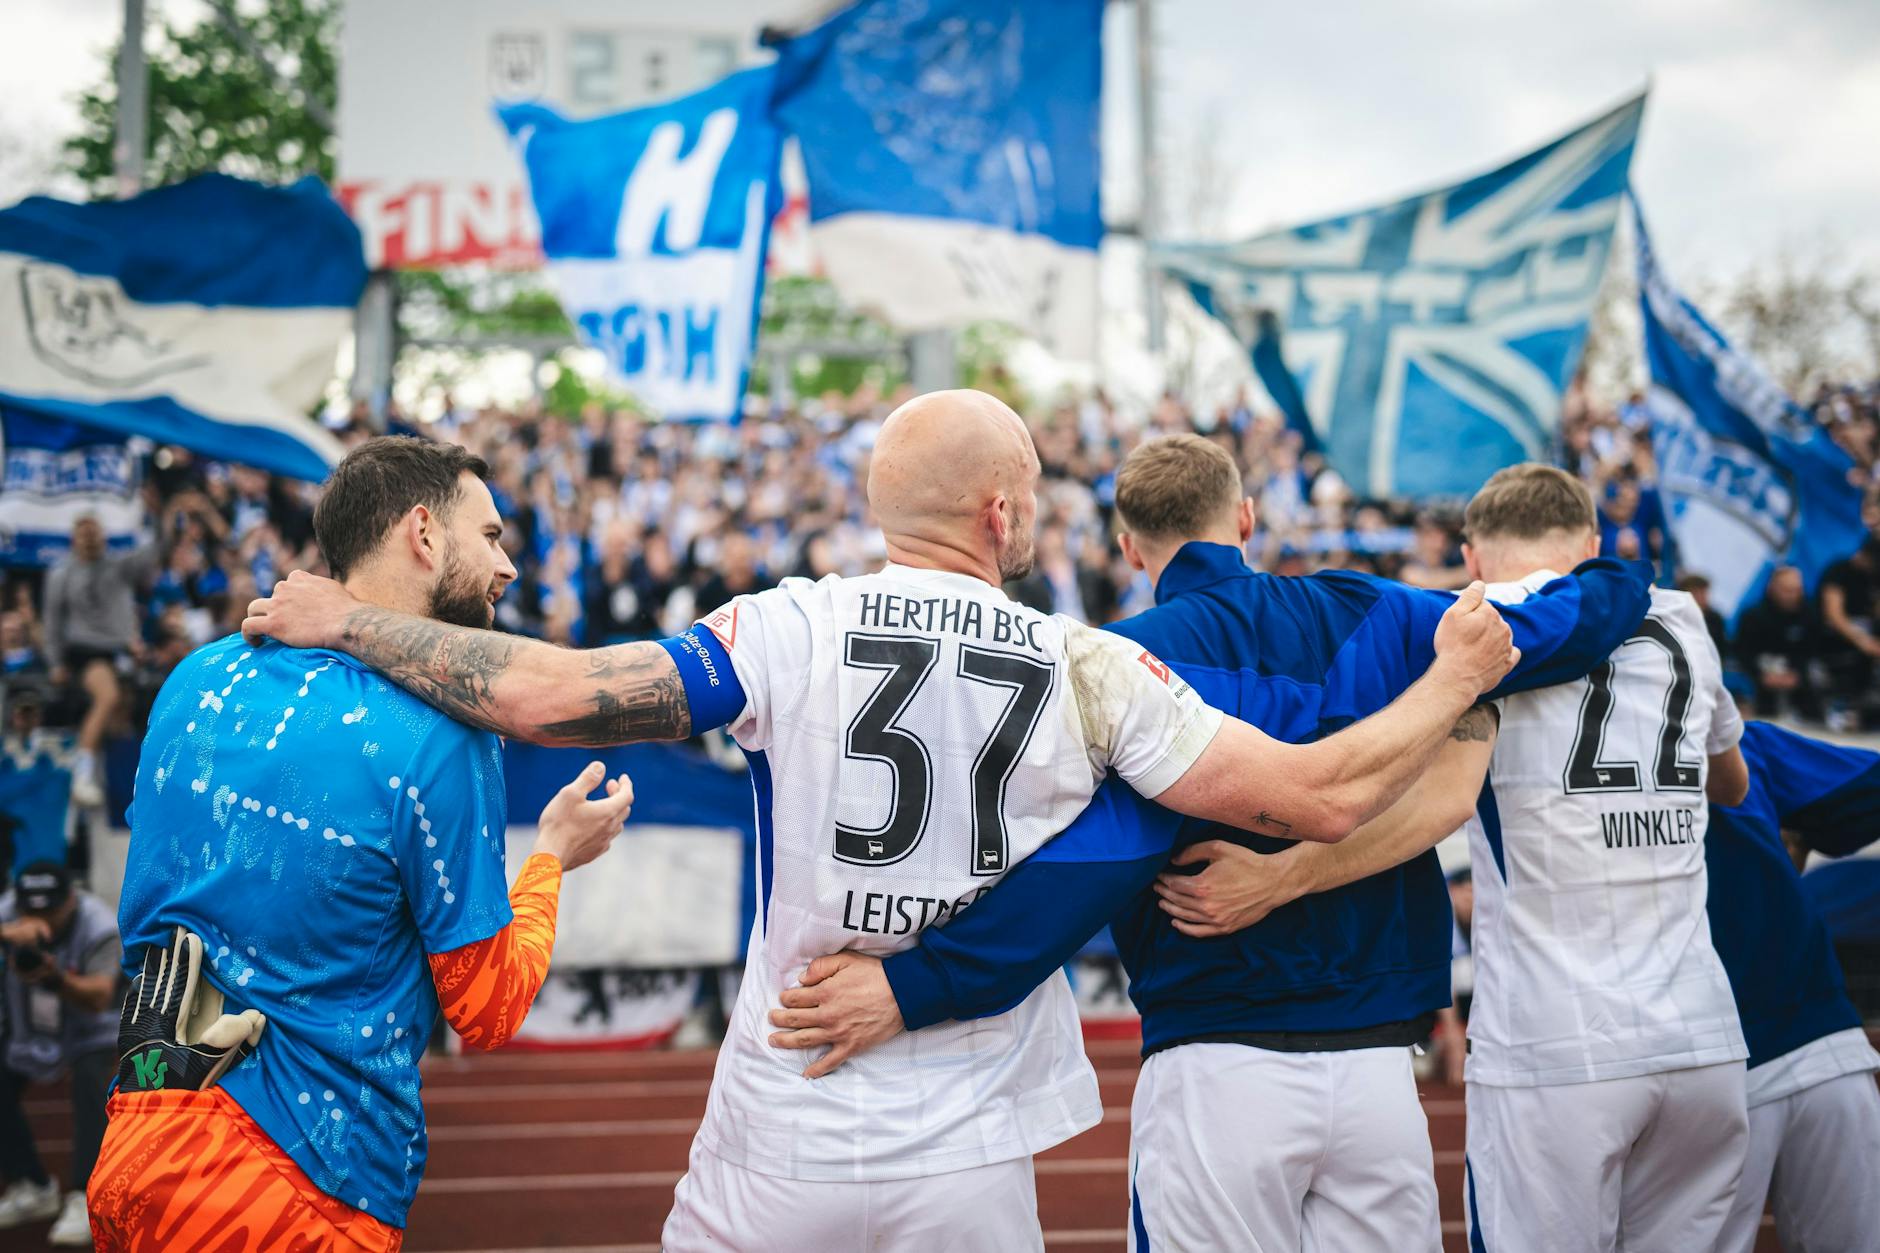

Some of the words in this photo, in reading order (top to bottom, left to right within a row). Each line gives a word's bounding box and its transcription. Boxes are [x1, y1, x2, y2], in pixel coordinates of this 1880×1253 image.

[860, 593, 981, 639] HERTHA
[993, 607, 1042, 652] BSC
[697, 647, 720, 688] Dame
[1563, 615, 1702, 795] 22
[833, 631, 1056, 877] 37
[1601, 808, 1696, 849] WINKLER
